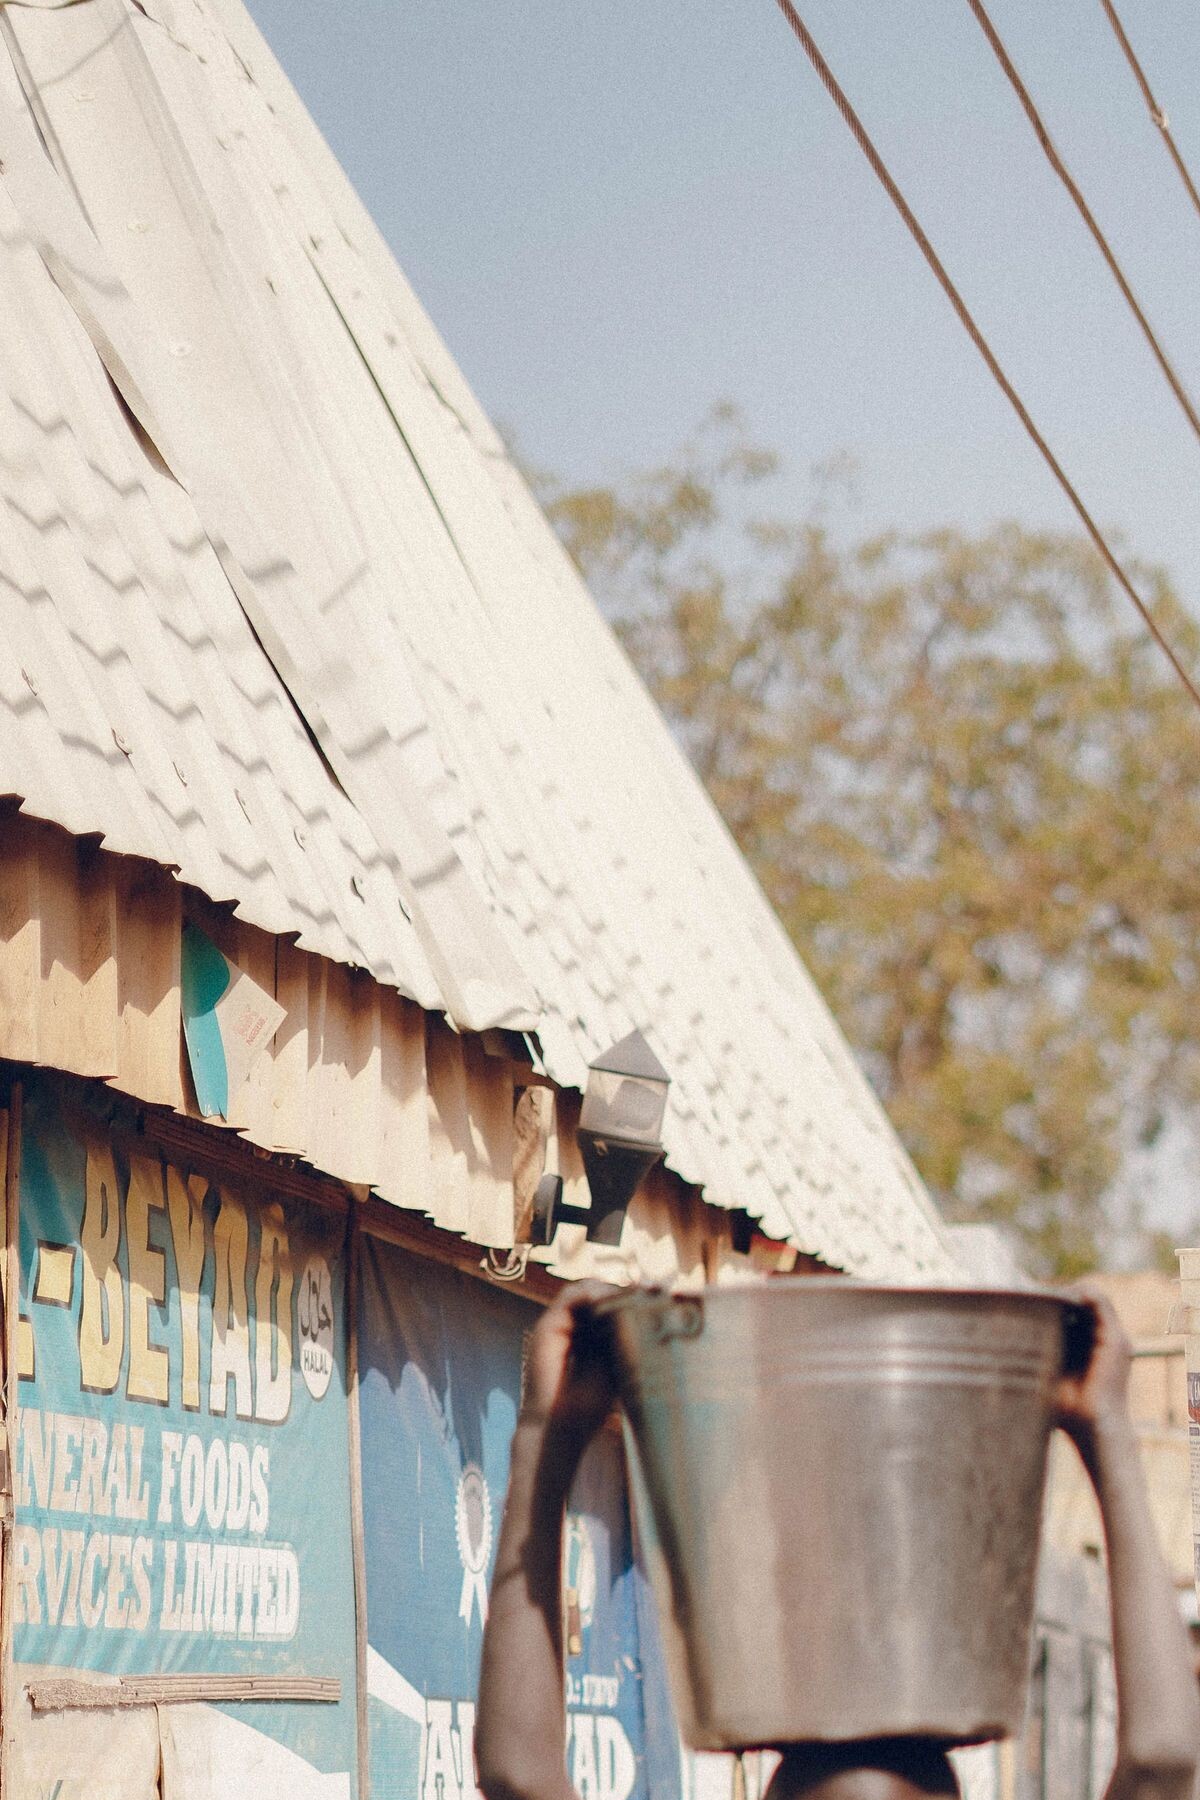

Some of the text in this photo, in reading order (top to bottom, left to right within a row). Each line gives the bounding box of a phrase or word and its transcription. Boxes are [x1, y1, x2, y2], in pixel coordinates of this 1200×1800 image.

[304, 1349, 329, 1376] HALAL
[157, 1430, 270, 1535] FOODS
[160, 1539, 299, 1640] LIMITED
